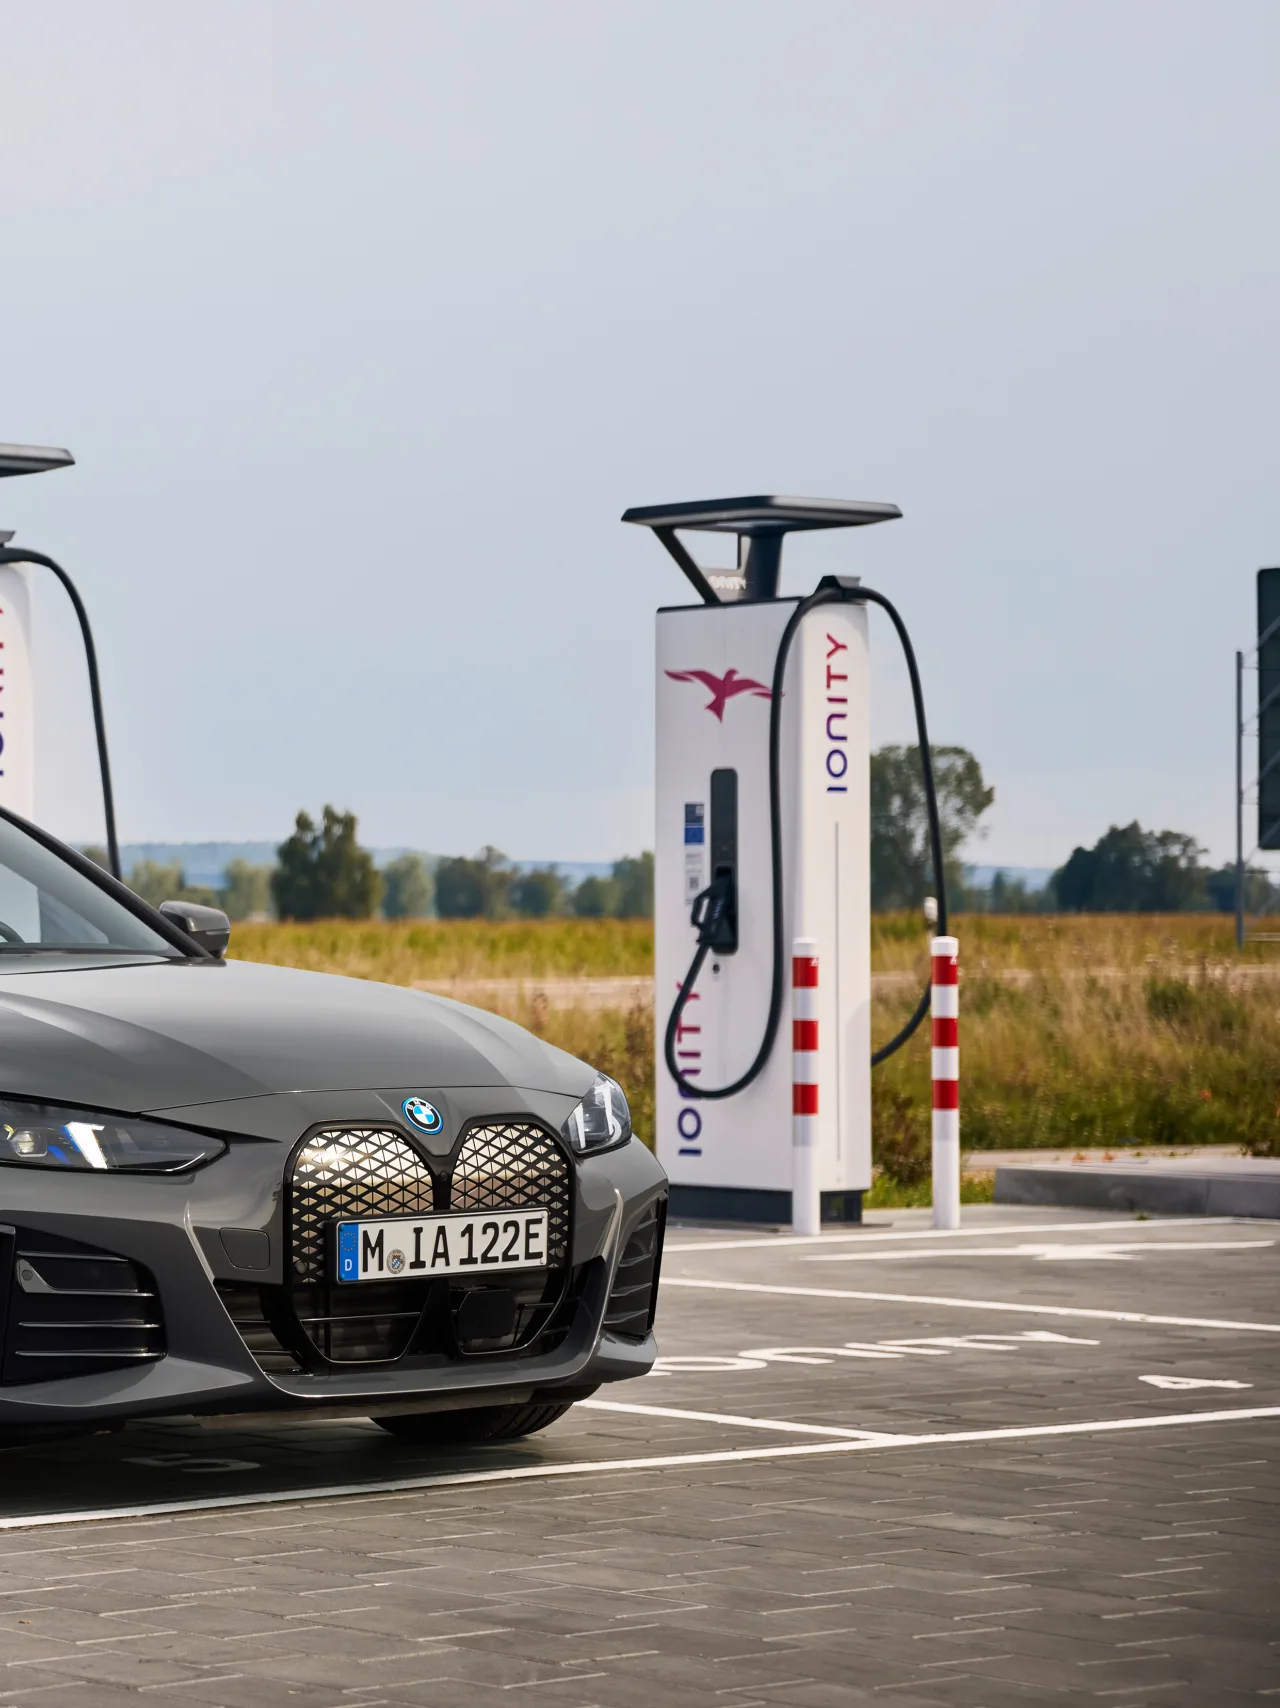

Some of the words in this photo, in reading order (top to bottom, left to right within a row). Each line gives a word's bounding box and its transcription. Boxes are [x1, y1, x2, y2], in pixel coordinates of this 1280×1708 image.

[826, 632, 848, 793] IONITY
[362, 1229, 384, 1272] M
[409, 1225, 451, 1270] IA
[459, 1217, 544, 1266] 122E
[345, 1259, 352, 1271] D
[1138, 1374, 1254, 1390] 4
